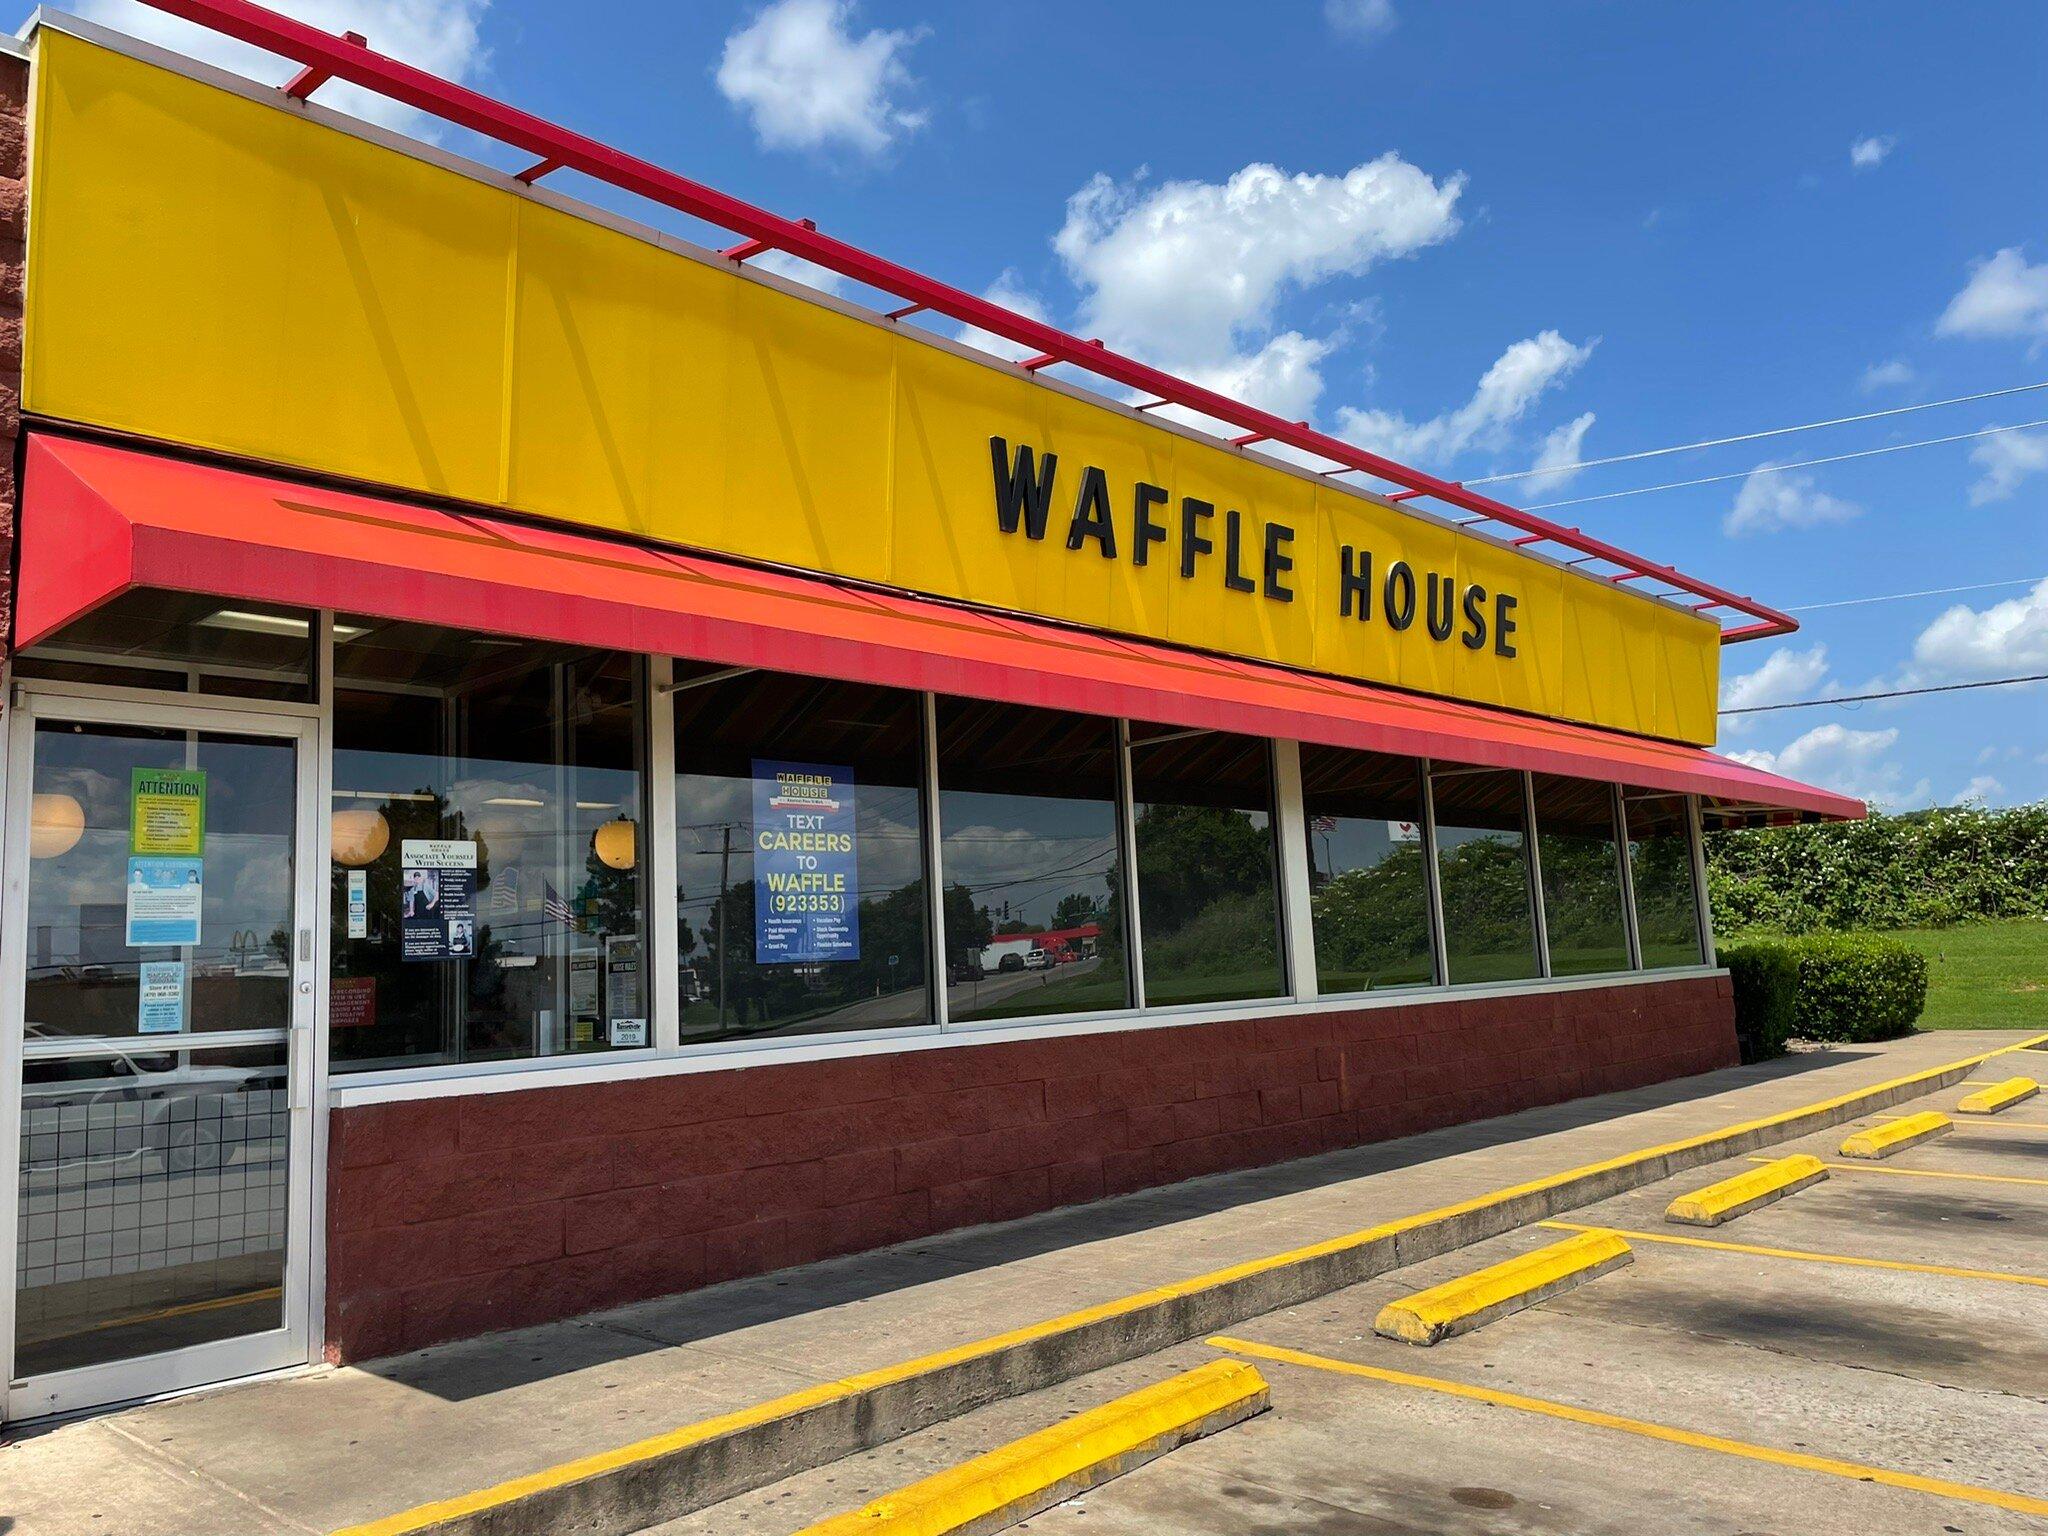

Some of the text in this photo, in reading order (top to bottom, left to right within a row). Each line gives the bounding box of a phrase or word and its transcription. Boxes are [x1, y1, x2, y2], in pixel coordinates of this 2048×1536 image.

[990, 435, 1517, 658] WAFFLE HOUSE
[777, 773, 832, 786] WAFFLE
[138, 780, 199, 796] ATTENTION
[782, 786, 828, 798] HOUSE
[786, 814, 824, 829] TEXT
[759, 831, 852, 852] CAREERS
[796, 856, 817, 870] TO
[767, 873, 845, 892] WAFFLE
[769, 894, 845, 914] (923353)
[621, 1033, 636, 1041] 2019
